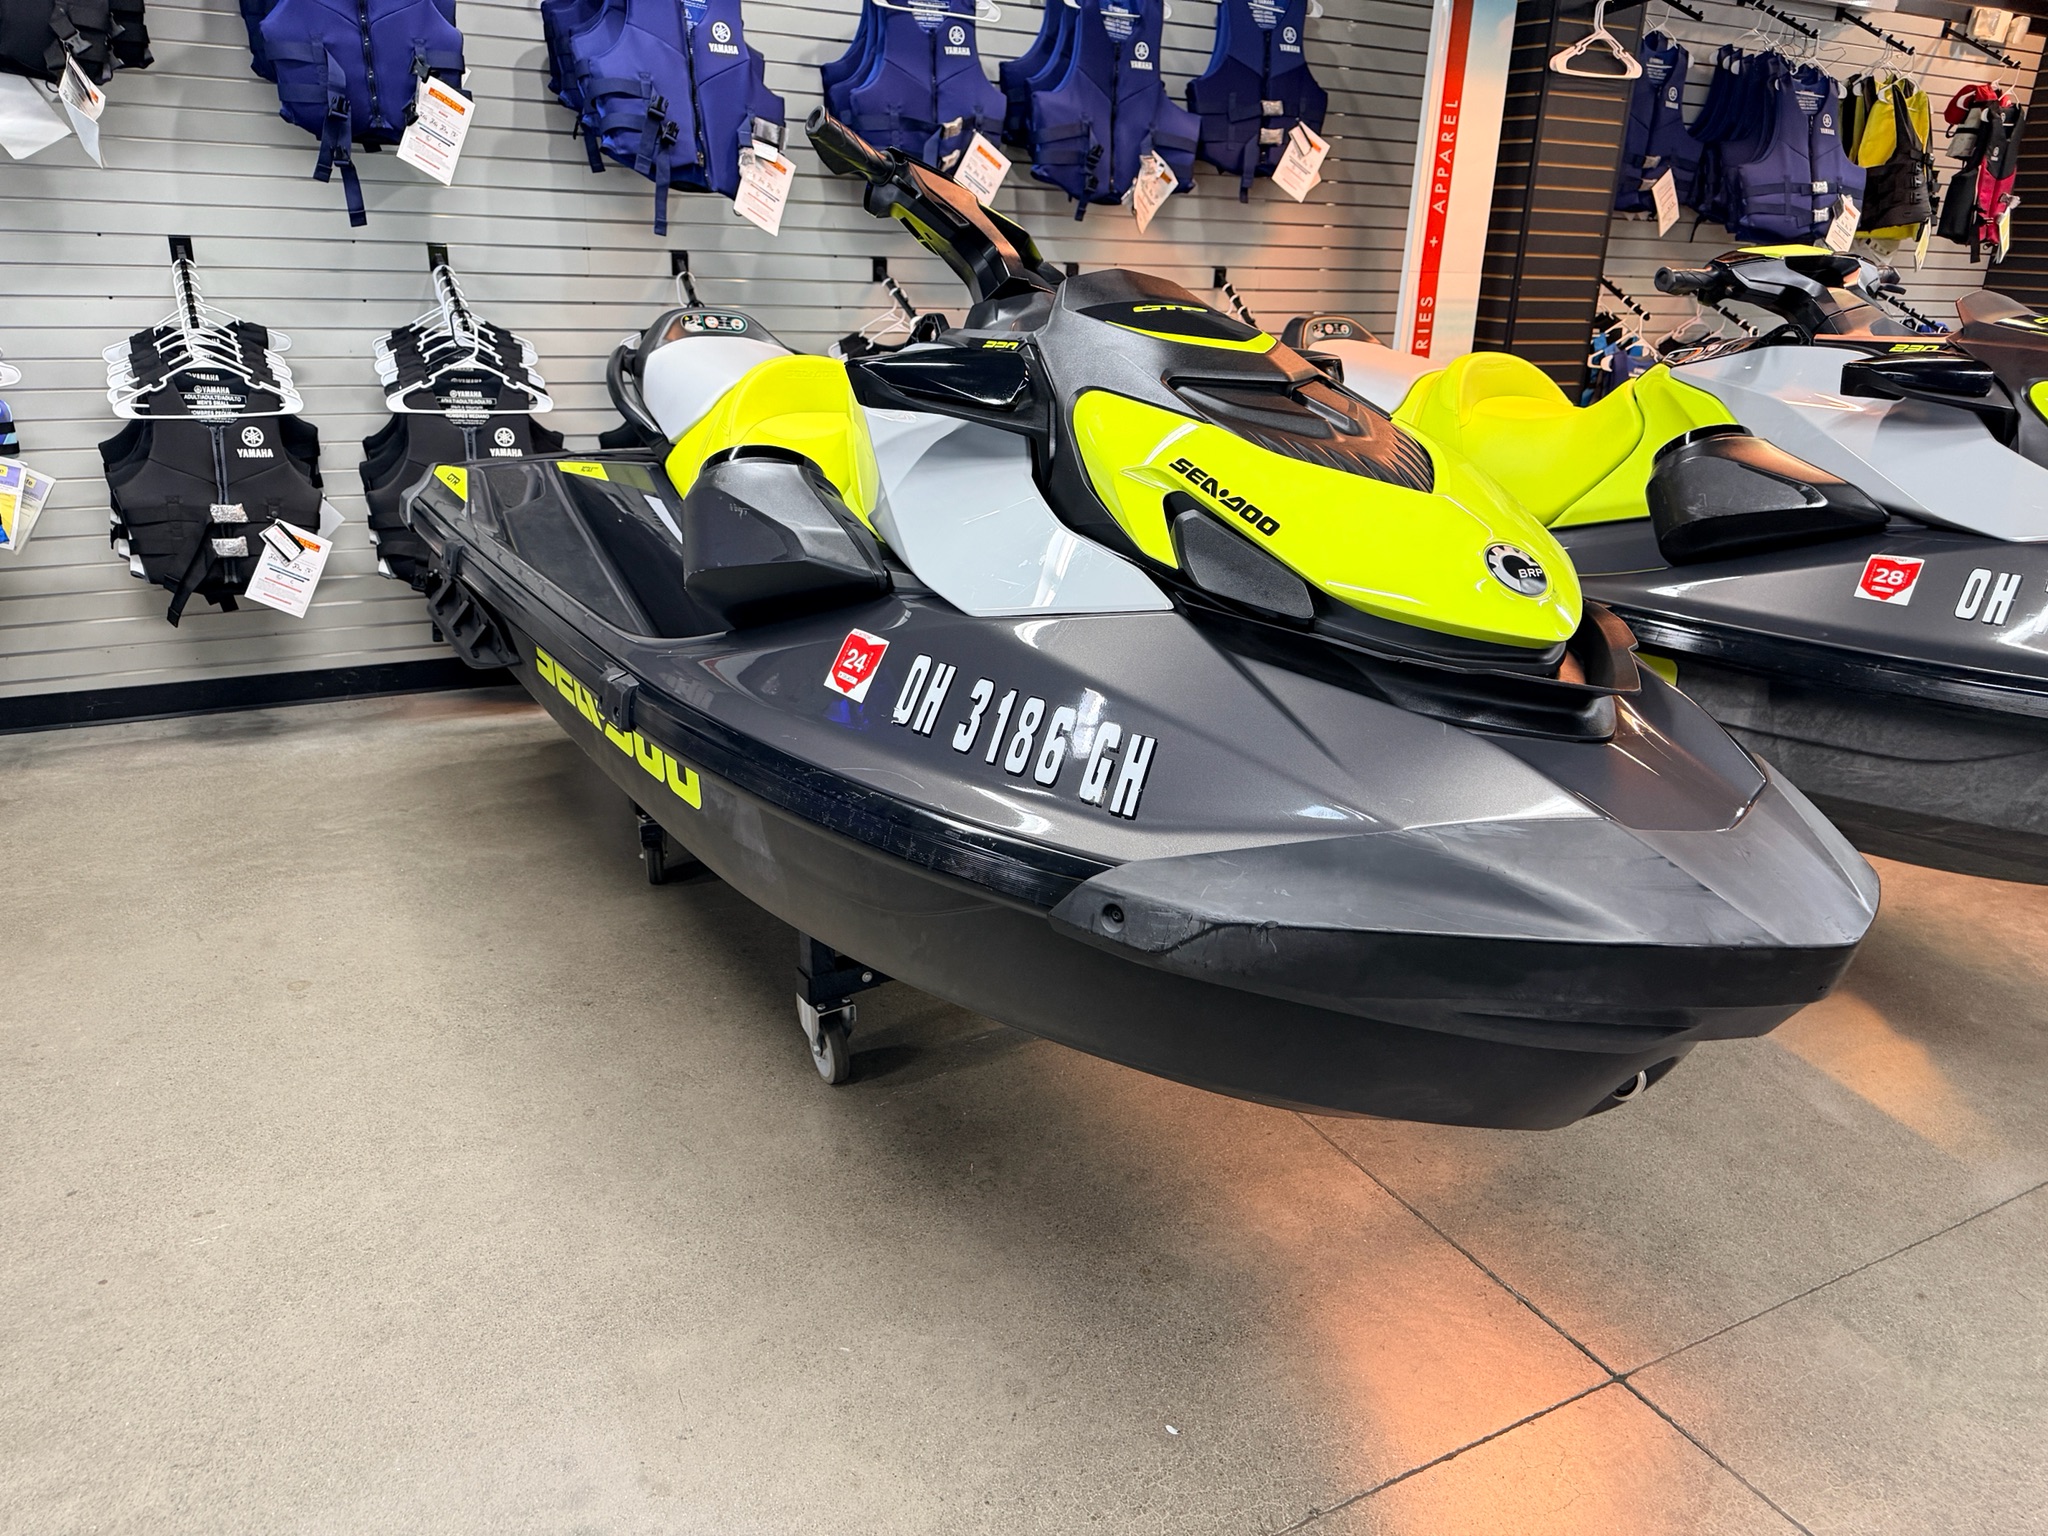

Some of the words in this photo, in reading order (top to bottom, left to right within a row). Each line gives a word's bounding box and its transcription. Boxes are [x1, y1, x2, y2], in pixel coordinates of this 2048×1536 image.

[708, 42, 739, 55] YAMAHA
[1432, 100, 1459, 214] APPAREL
[1888, 343, 1940, 353] 230
[202, 385, 231, 394] YAMAHA
[236, 448, 274, 458] YAMAHA
[489, 447, 523, 457] YAMAHA
[1517, 567, 1544, 579] BRP
[1872, 567, 1906, 586] 28
[1954, 567, 2023, 627] OH
[842, 648, 869, 674] 24
[892, 653, 957, 737] OH
[952, 677, 1078, 788] 3186
[1078, 720, 1158, 820] GH
